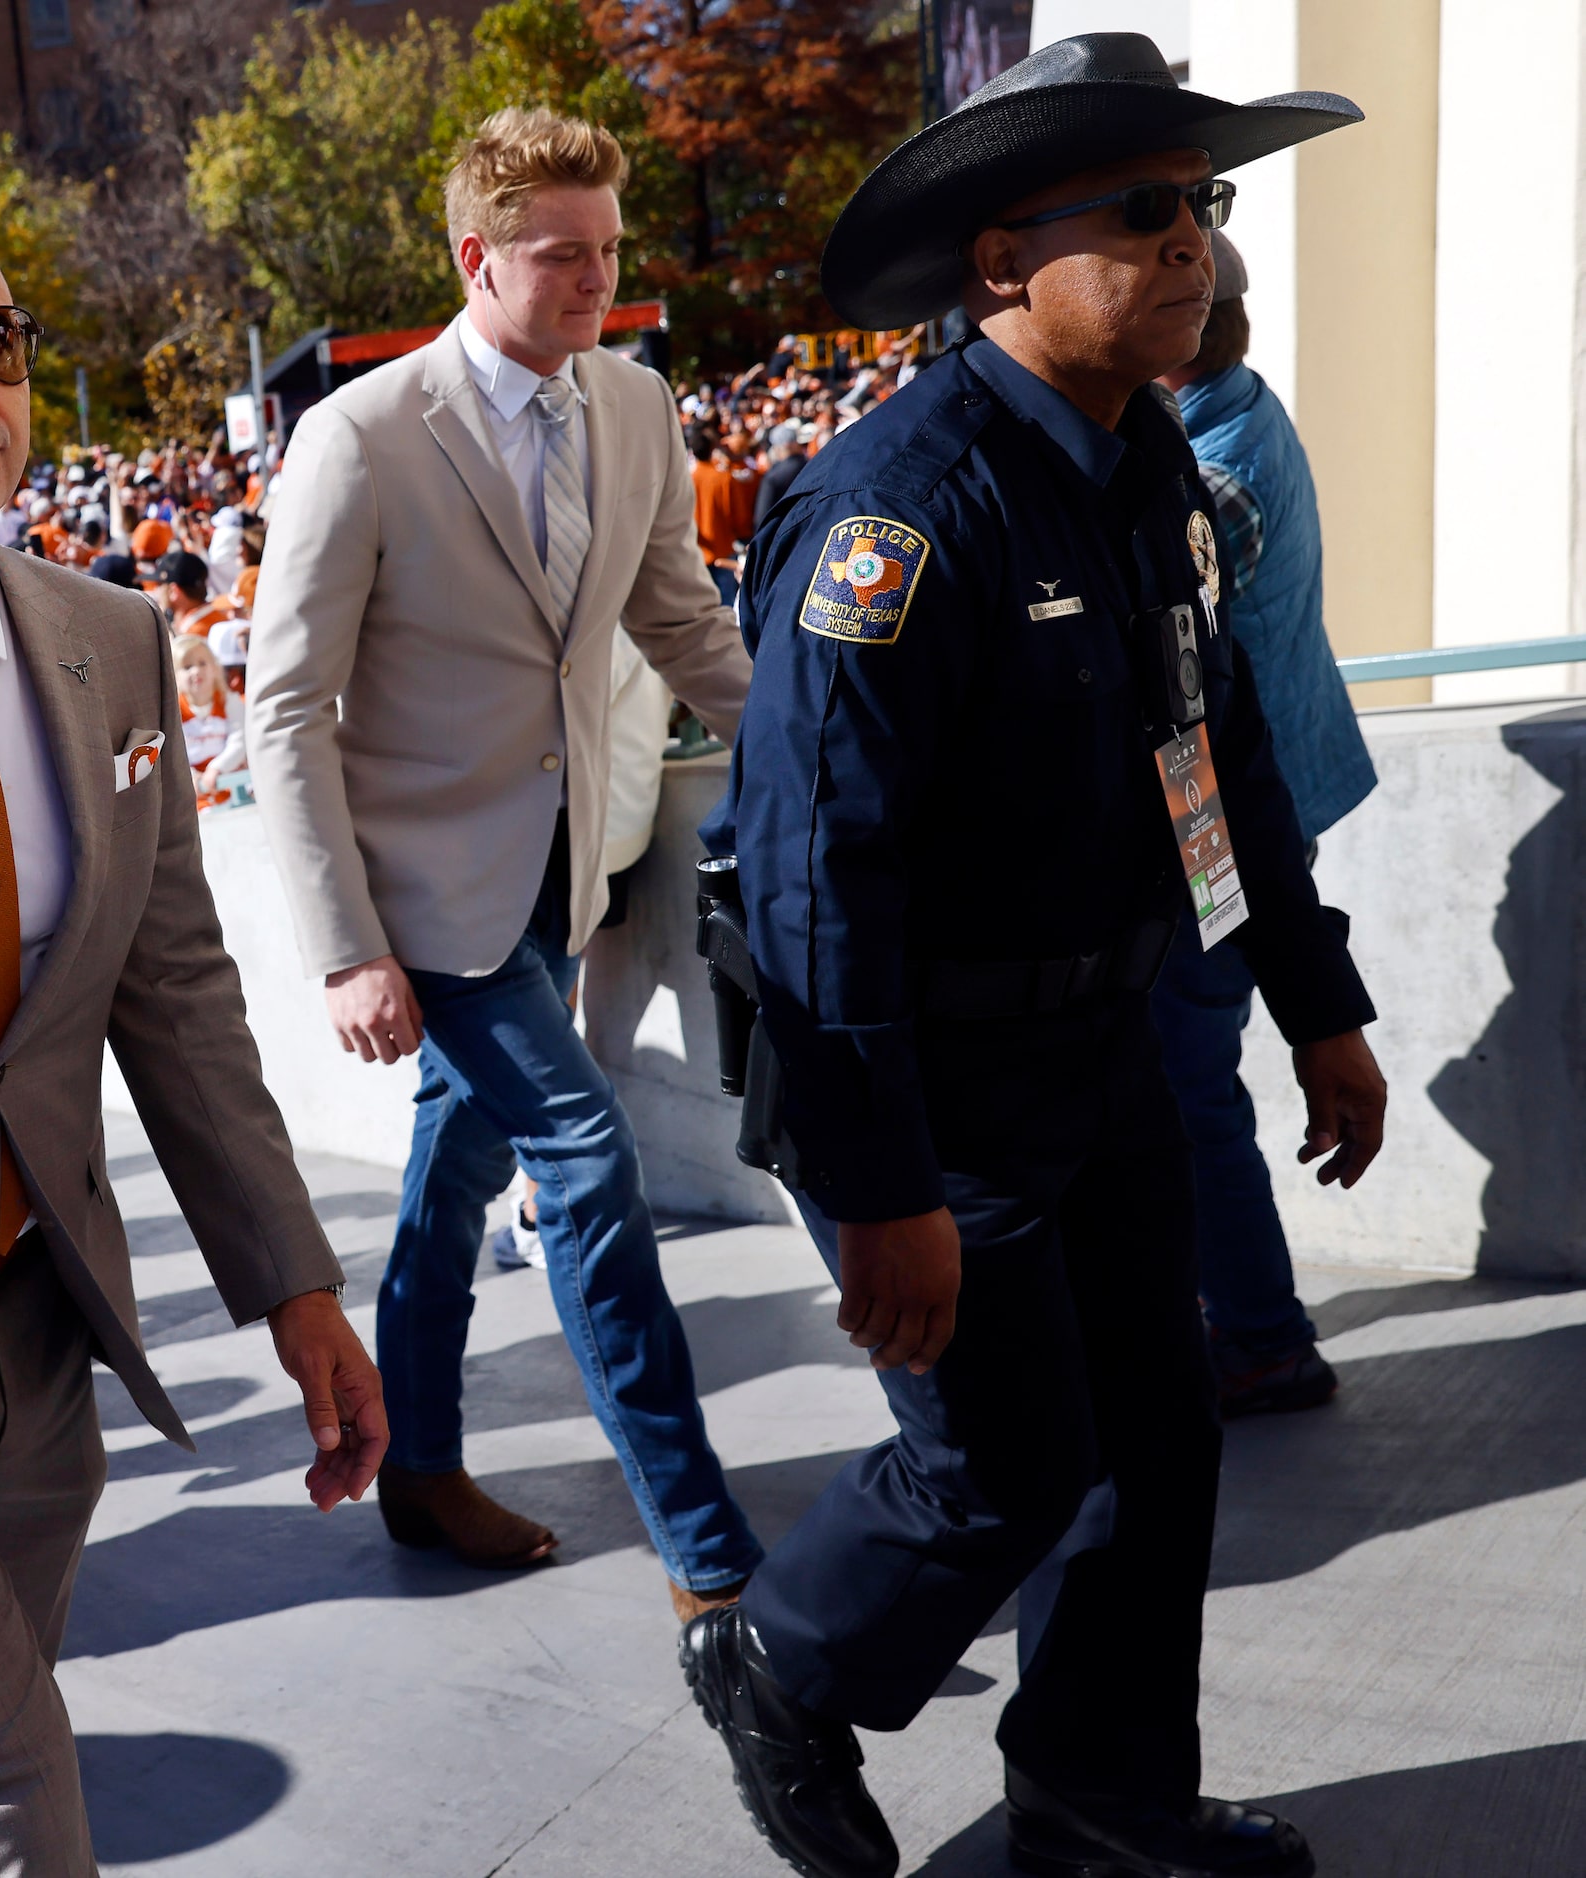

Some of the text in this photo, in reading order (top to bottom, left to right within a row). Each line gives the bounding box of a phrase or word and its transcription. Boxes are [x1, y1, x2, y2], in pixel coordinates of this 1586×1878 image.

[837, 523, 919, 554] POLICE
[810, 593, 900, 622] UNIVERSITY OF TEXAS
[825, 616, 863, 636] SYSTEM
[1207, 854, 1234, 881] ALL ACCESS
[1195, 881, 1211, 911] AA
